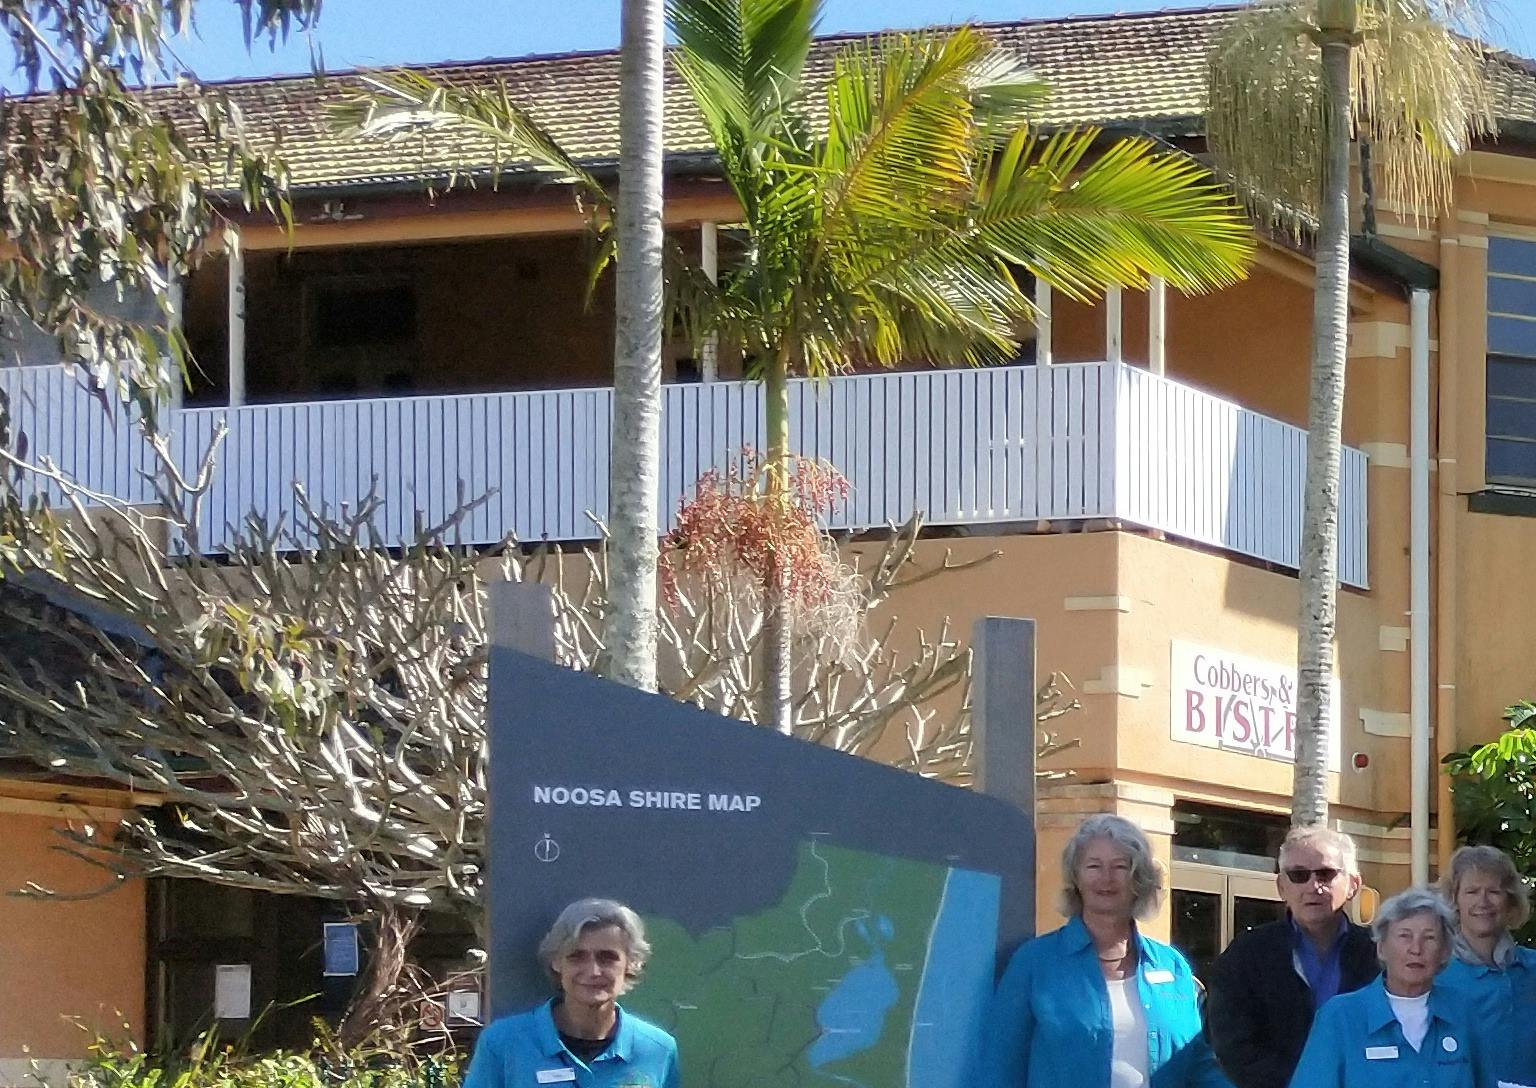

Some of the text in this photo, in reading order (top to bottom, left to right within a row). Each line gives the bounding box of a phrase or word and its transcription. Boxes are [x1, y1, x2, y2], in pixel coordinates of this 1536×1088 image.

[534, 785, 762, 812] NOOSA SHIRE MAP
